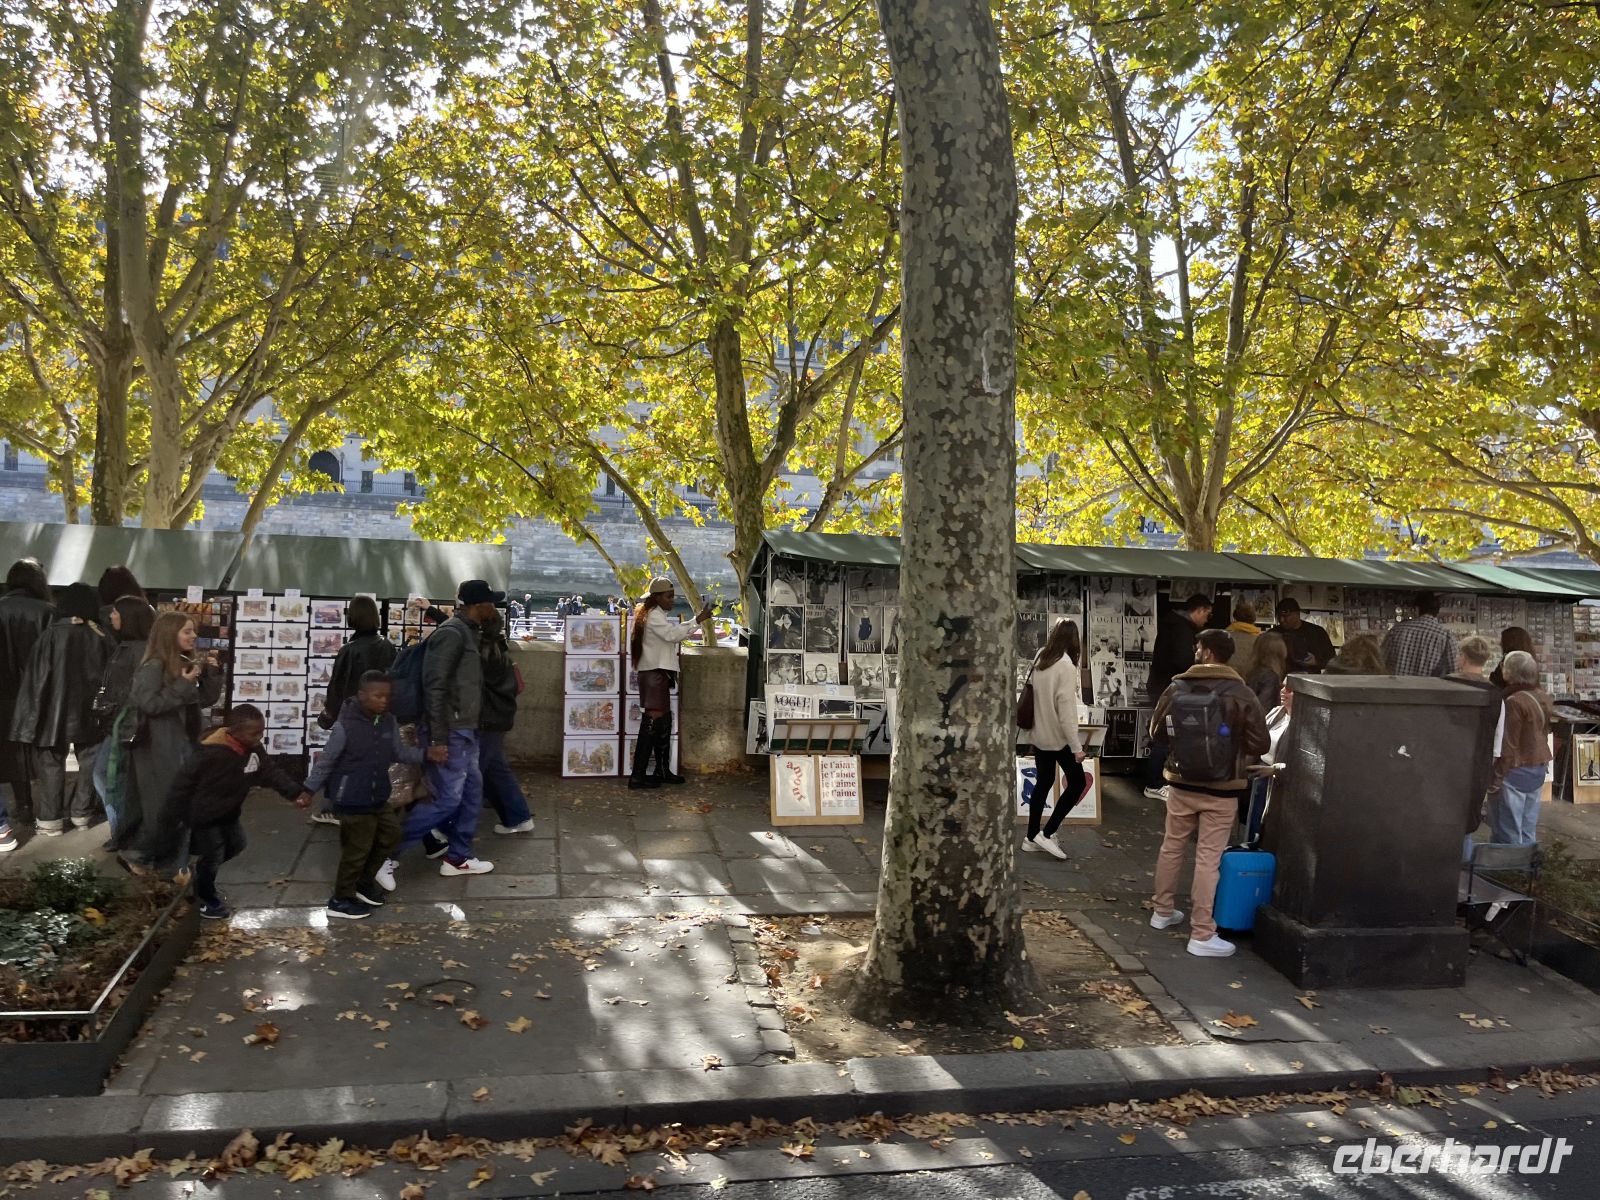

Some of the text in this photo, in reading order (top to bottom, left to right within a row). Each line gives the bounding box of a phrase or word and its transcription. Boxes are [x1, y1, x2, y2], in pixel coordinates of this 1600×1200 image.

[775, 694, 811, 708] VOGUE
[244, 752, 260, 773] A
[821, 761, 829, 770] je
[821, 770, 829, 779] je
[822, 780, 830, 788] je
[822, 789, 857, 798] je t'aime
